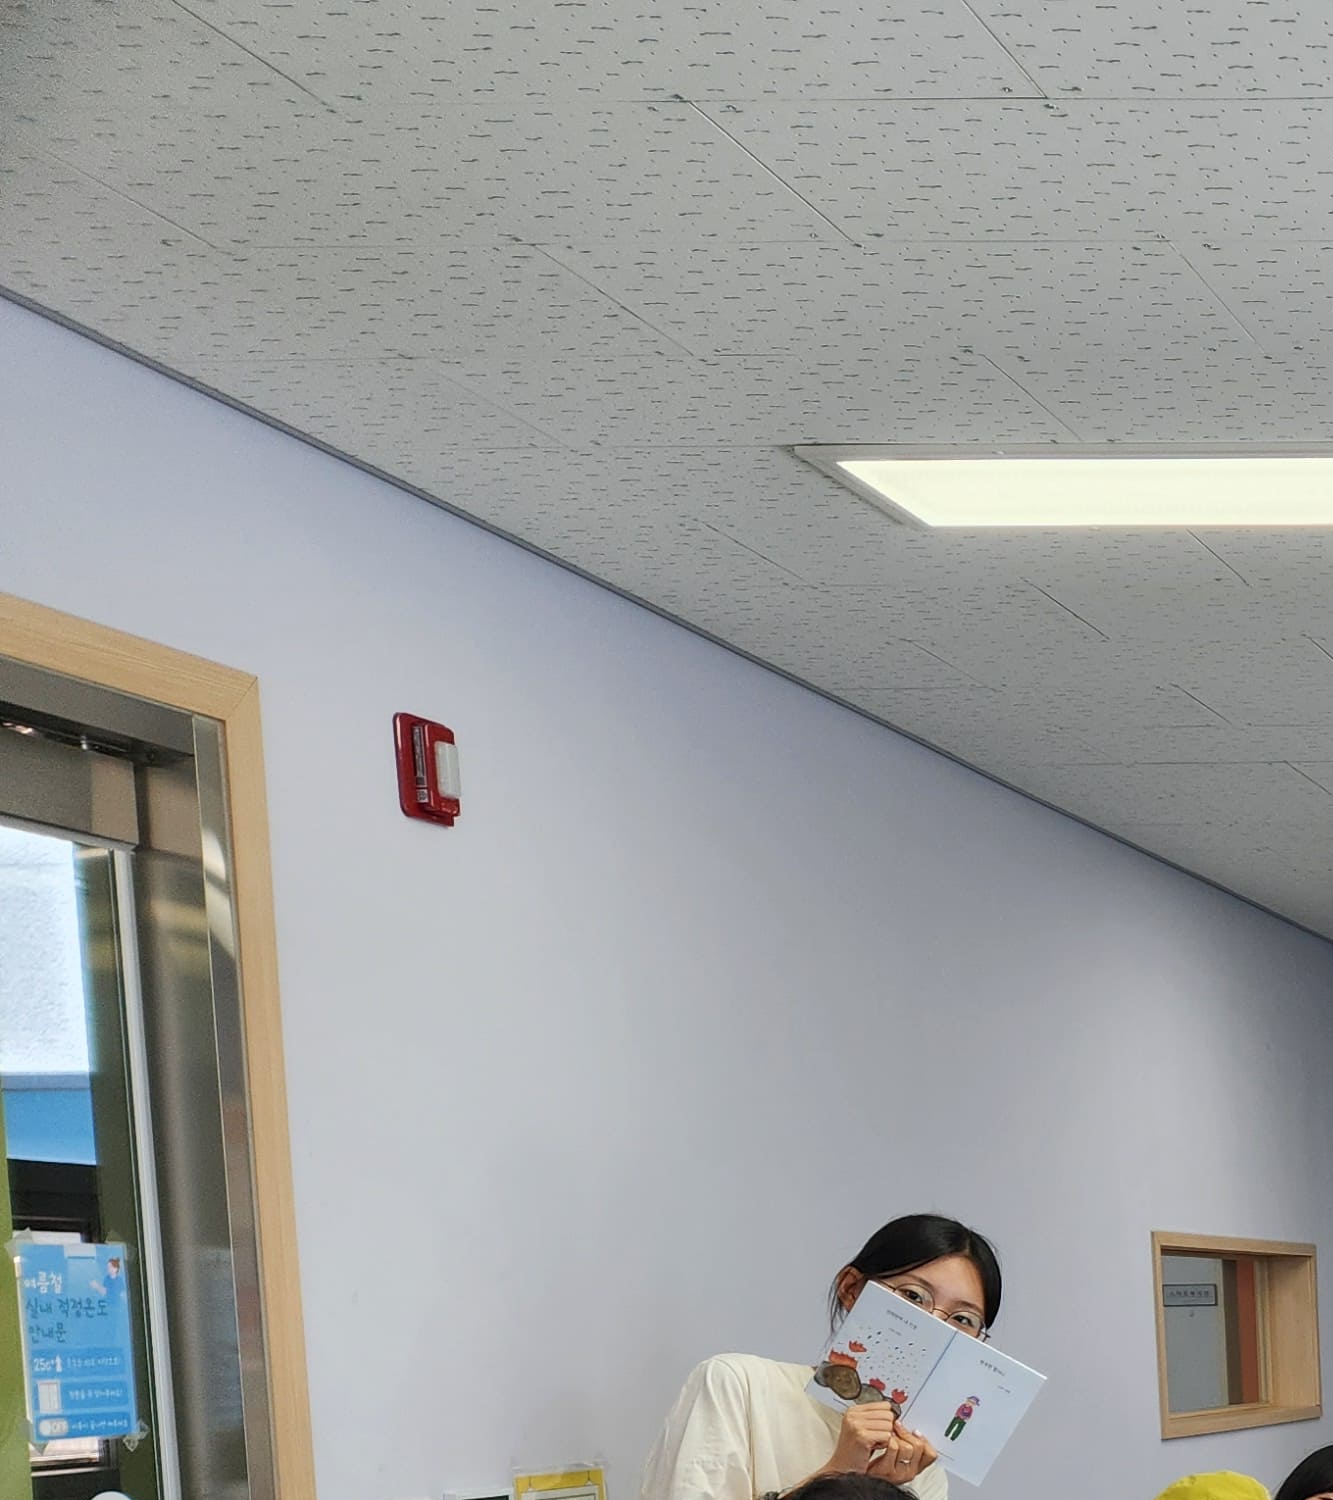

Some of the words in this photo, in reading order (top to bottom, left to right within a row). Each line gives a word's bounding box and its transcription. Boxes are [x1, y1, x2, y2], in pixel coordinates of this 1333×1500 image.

[23, 1271, 62, 1294] 여름철
[25, 1297, 53, 1319] 실내
[58, 1297, 108, 1319] 적정온도
[28, 1322, 67, 1344] 안내문
